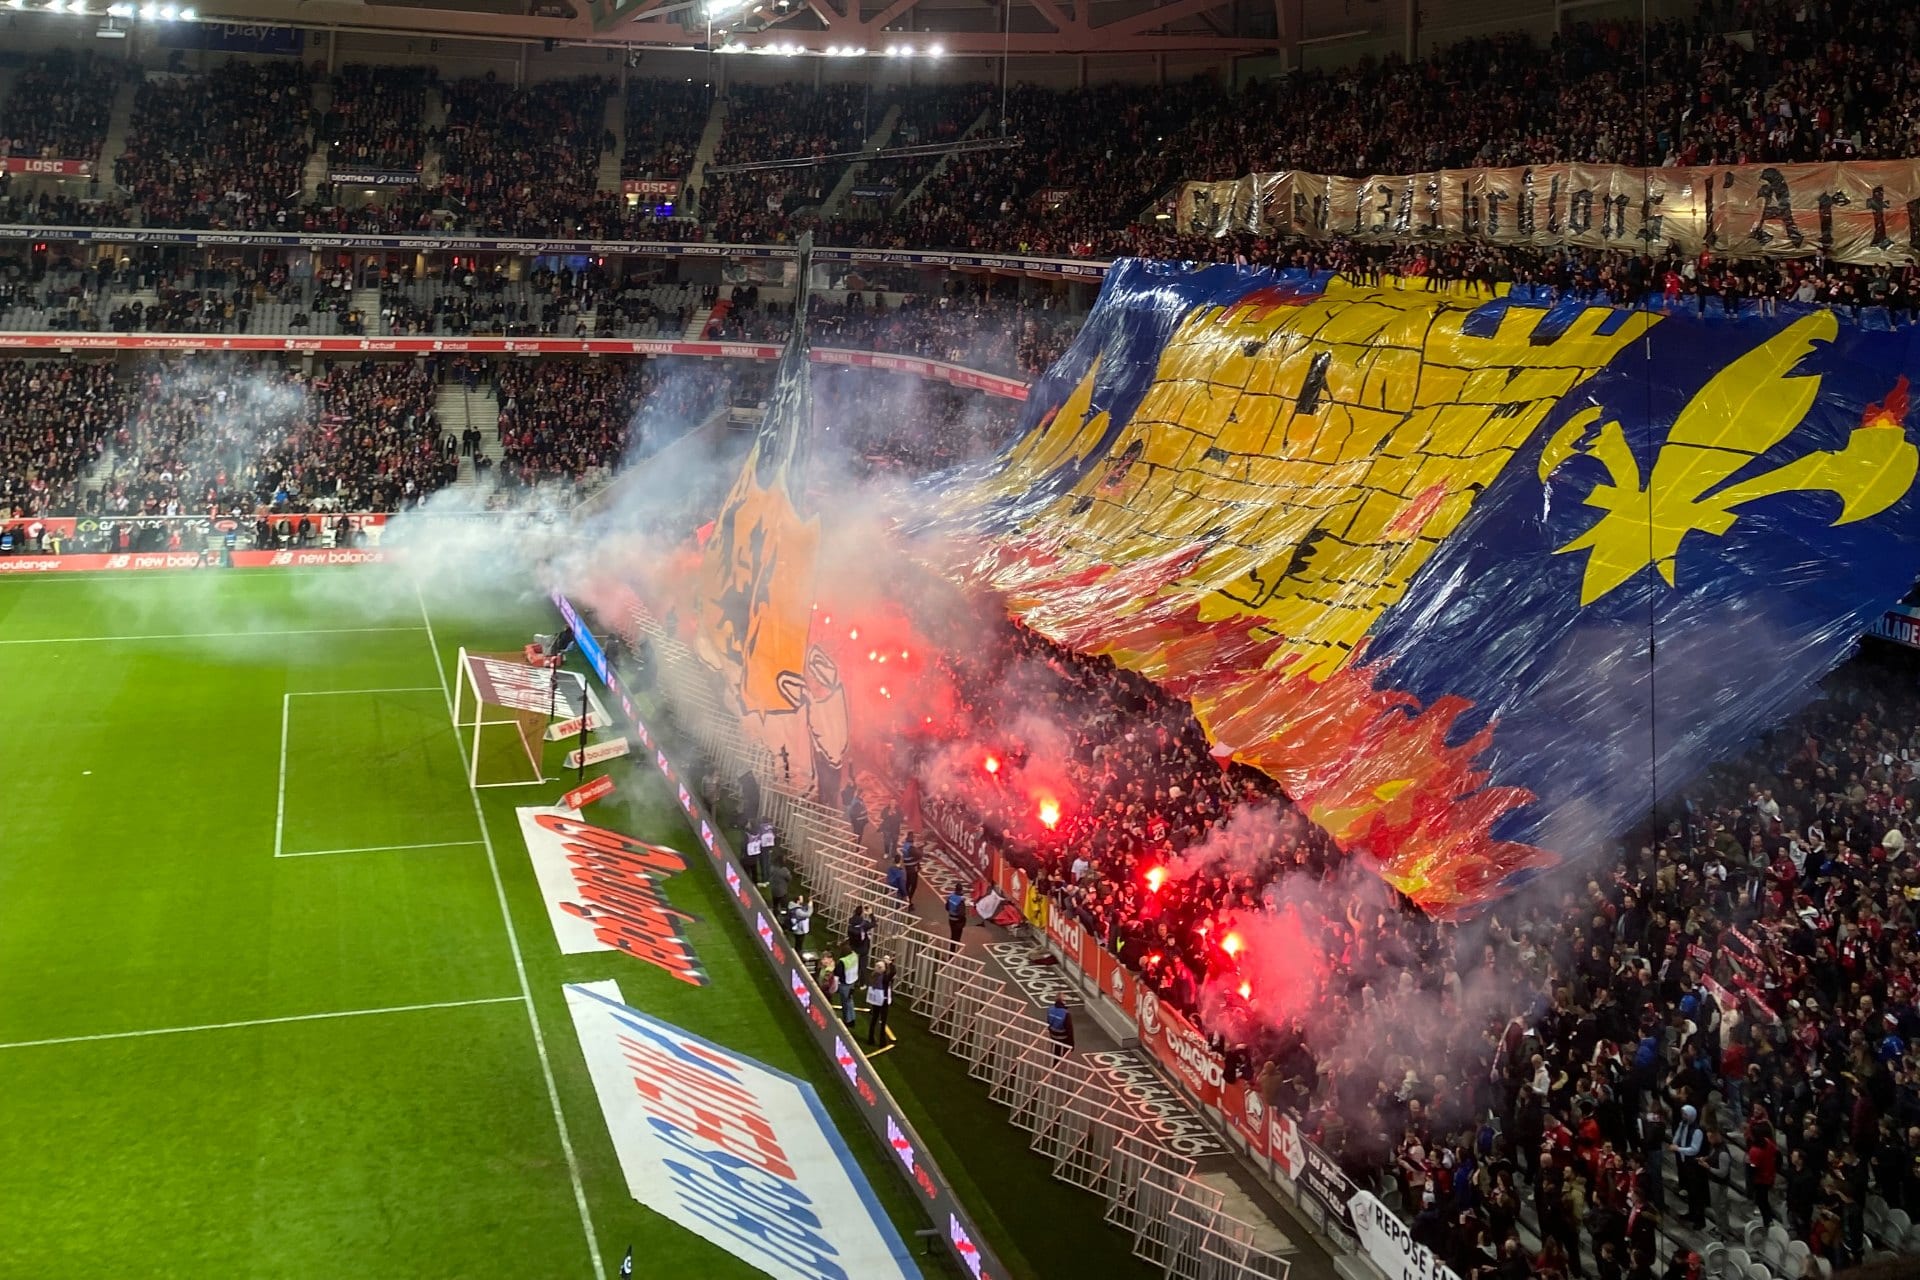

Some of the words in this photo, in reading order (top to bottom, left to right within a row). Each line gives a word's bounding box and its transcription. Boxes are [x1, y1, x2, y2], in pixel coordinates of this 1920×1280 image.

[25, 160, 63, 172] LOSC
[331, 174, 375, 182] DECATHLON
[635, 182, 668, 193] LOSC
[91, 232, 135, 240] DECATHLON
[400, 240, 440, 248] DECATHLON
[497, 242, 536, 250] DECATHLON
[443, 342, 468, 350] actual
[515, 343, 539, 351] actual
[632, 344, 673, 353] WINAMAX
[721, 346, 759, 357] WINAMAX
[135, 555, 166, 568] new
[299, 553, 326, 563] new
[1049, 903, 1079, 952] Nord
[616, 1034, 849, 1280] INTERSPORT
[1376, 1204, 1428, 1275] REPOSE
